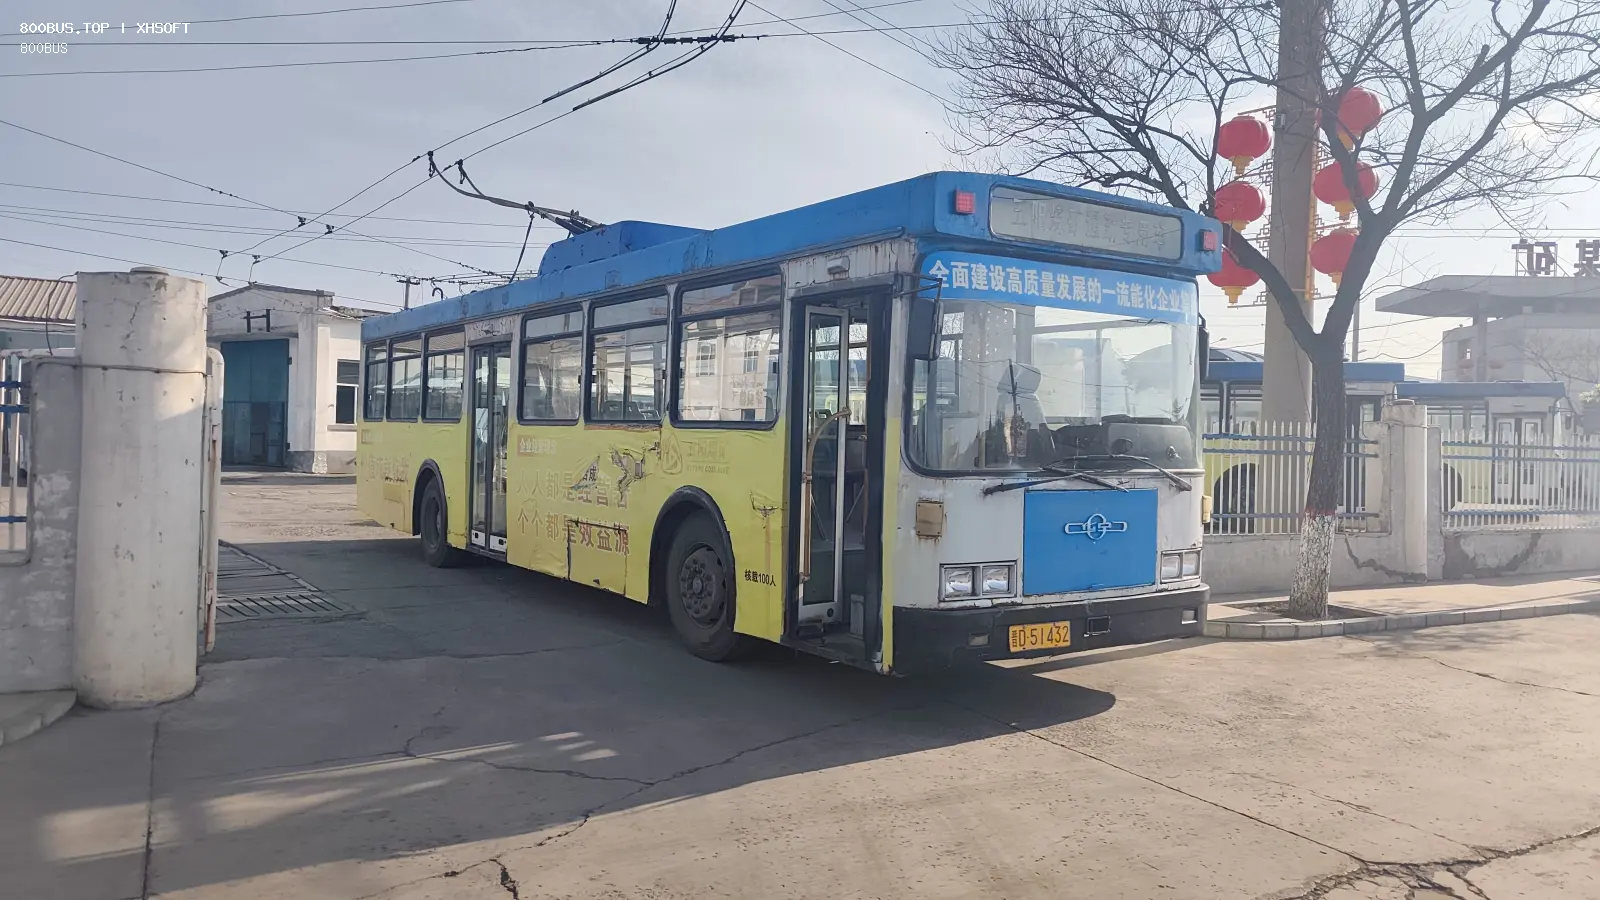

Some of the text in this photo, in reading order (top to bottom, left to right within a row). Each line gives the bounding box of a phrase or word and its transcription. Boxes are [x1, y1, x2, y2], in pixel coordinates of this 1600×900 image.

[516, 506, 631, 556] 个个都是效益源
[744, 569, 777, 587] 核载100人
